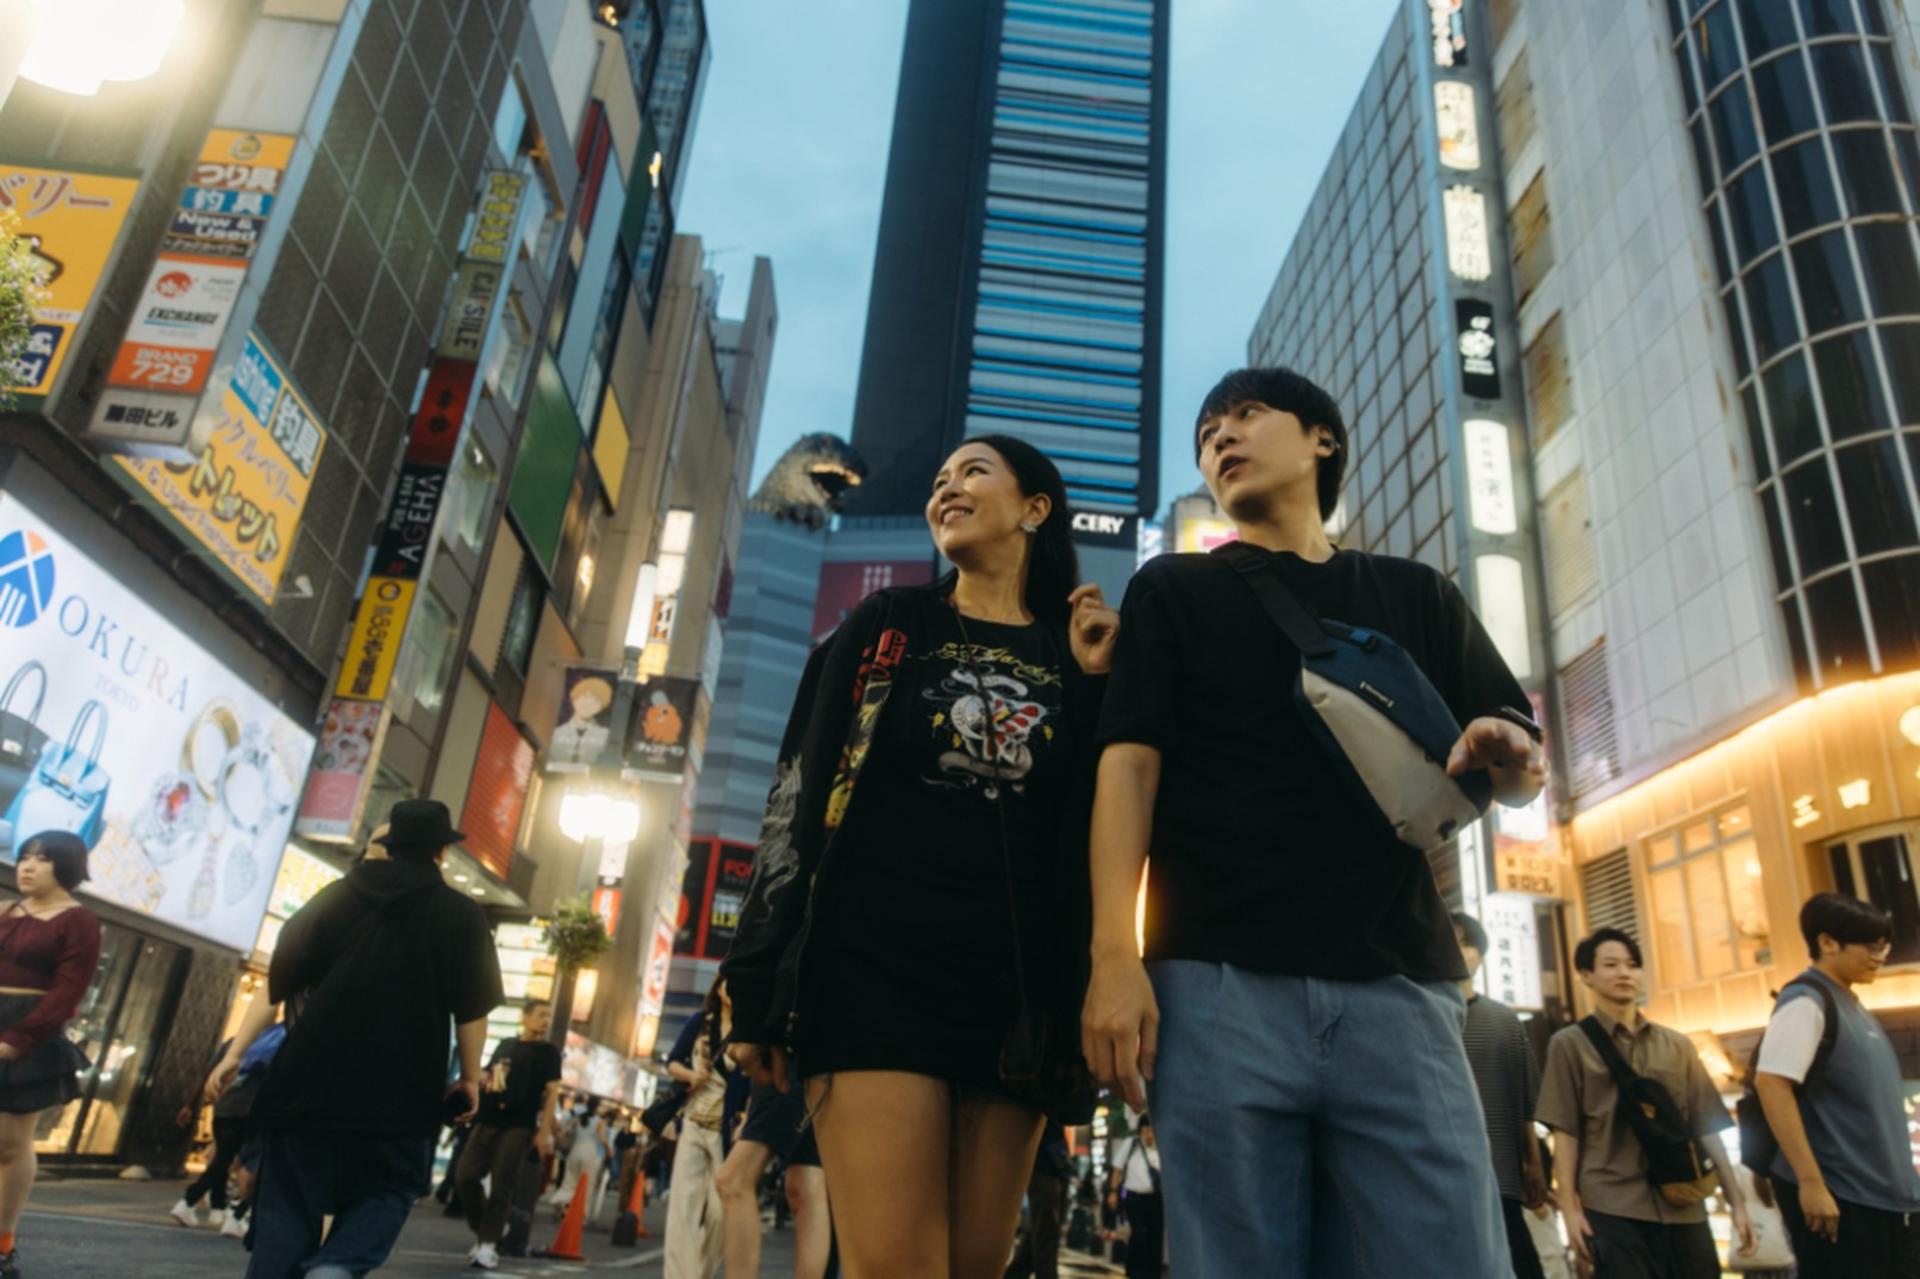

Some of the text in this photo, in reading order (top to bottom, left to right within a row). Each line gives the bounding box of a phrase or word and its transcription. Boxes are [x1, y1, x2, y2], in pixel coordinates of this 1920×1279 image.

[194, 164, 279, 192] つり具
[178, 211, 233, 228] New
[194, 226, 257, 241] Used
[148, 307, 219, 326] EXCHANGE
[137, 347, 198, 365] BRAND
[129, 359, 194, 385] 729
[398, 473, 443, 564] AGEHA
[58, 593, 189, 712] OKURA
